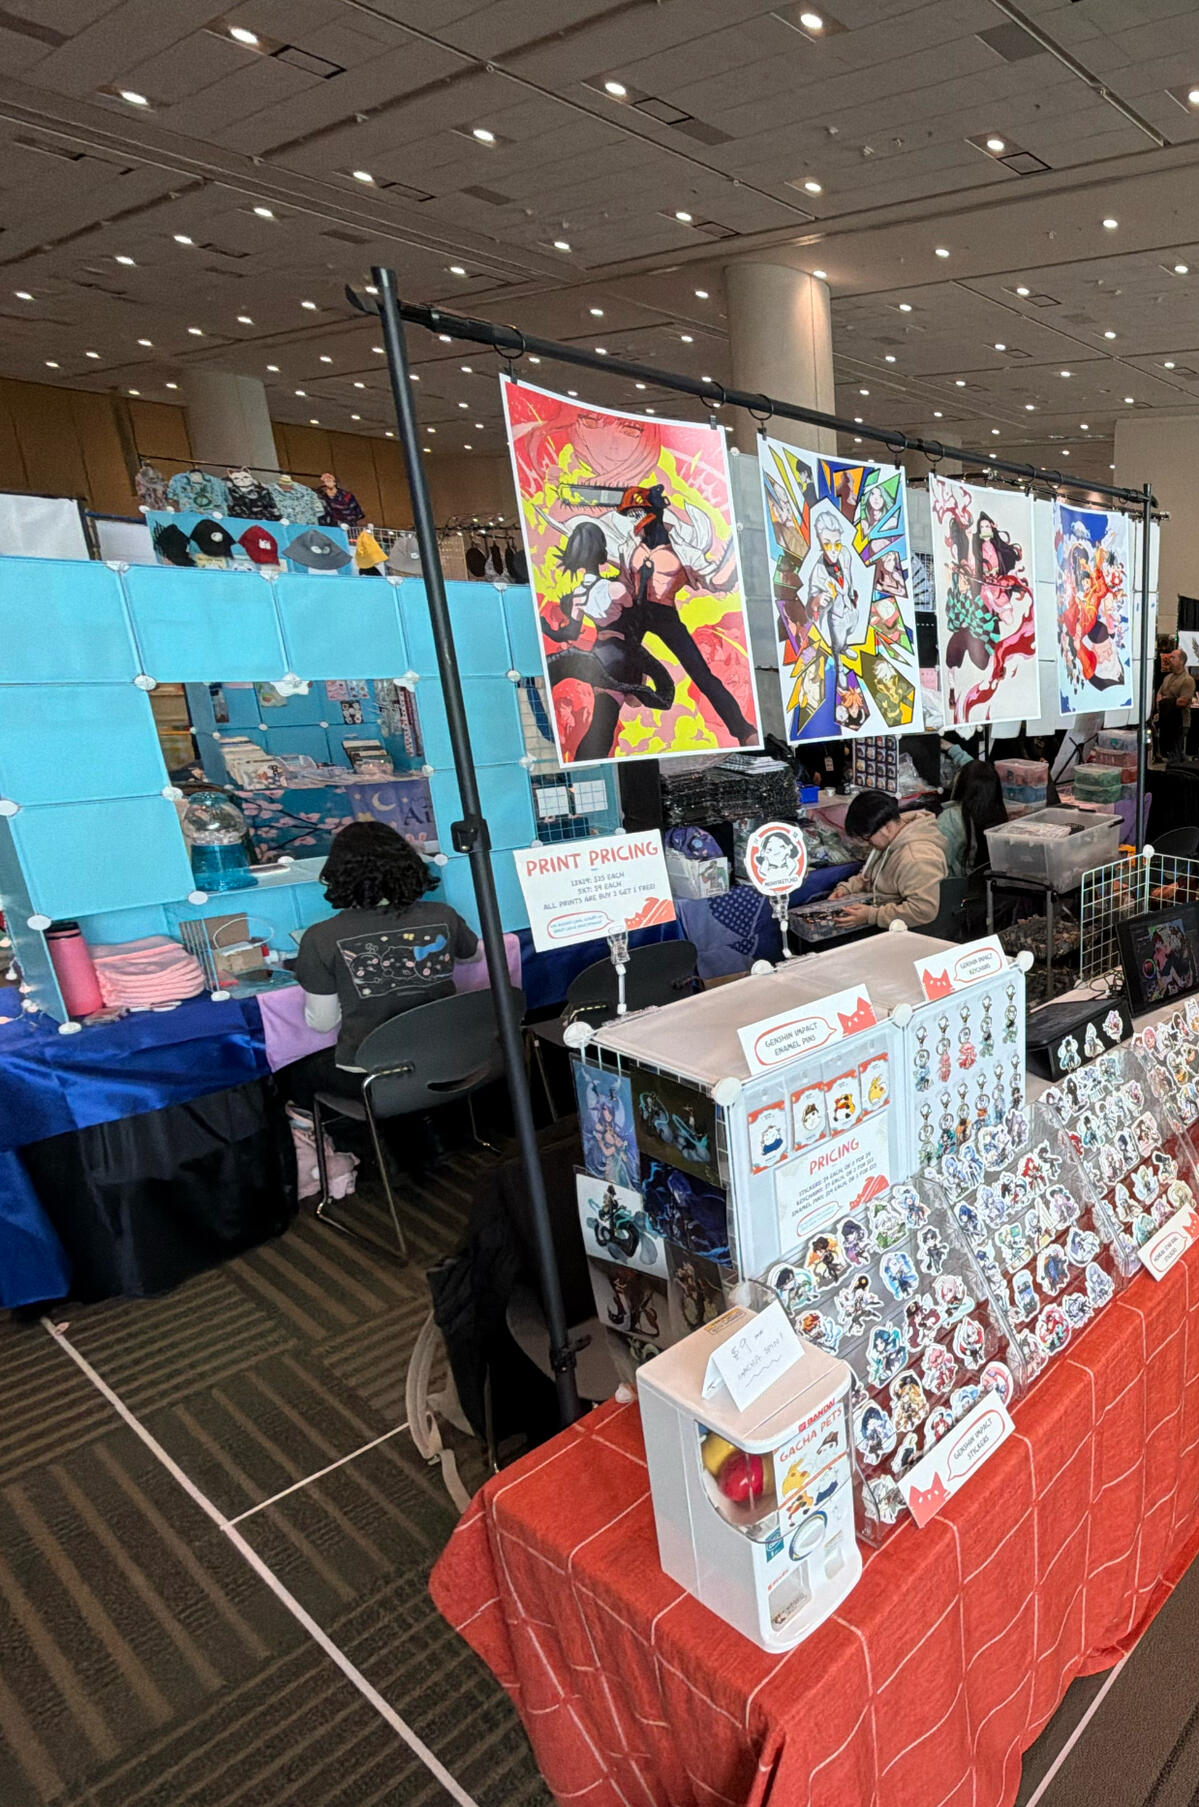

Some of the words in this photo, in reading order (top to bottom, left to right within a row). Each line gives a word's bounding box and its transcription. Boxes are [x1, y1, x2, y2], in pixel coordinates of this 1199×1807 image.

[526, 853, 581, 876] PRINT
[589, 841, 658, 866] PRICING
[604, 881, 622, 891] EACH
[607, 872, 625, 881] EACH
[544, 902, 558, 911] ALL
[765, 1031, 794, 1048] GENSHIN
[794, 1022, 819, 1036] IMPACT
[774, 1041, 801, 1056] ENAMEL
[802, 1034, 816, 1045] PINS
[809, 1138, 859, 1175] PRICING
[780, 1430, 817, 1463] GACHA
[821, 1407, 842, 1432] PETS
[953, 1436, 975, 1460] GENSHIN
[975, 1417, 993, 1438] IMPACT
[967, 1435, 990, 1460] STICKERS
